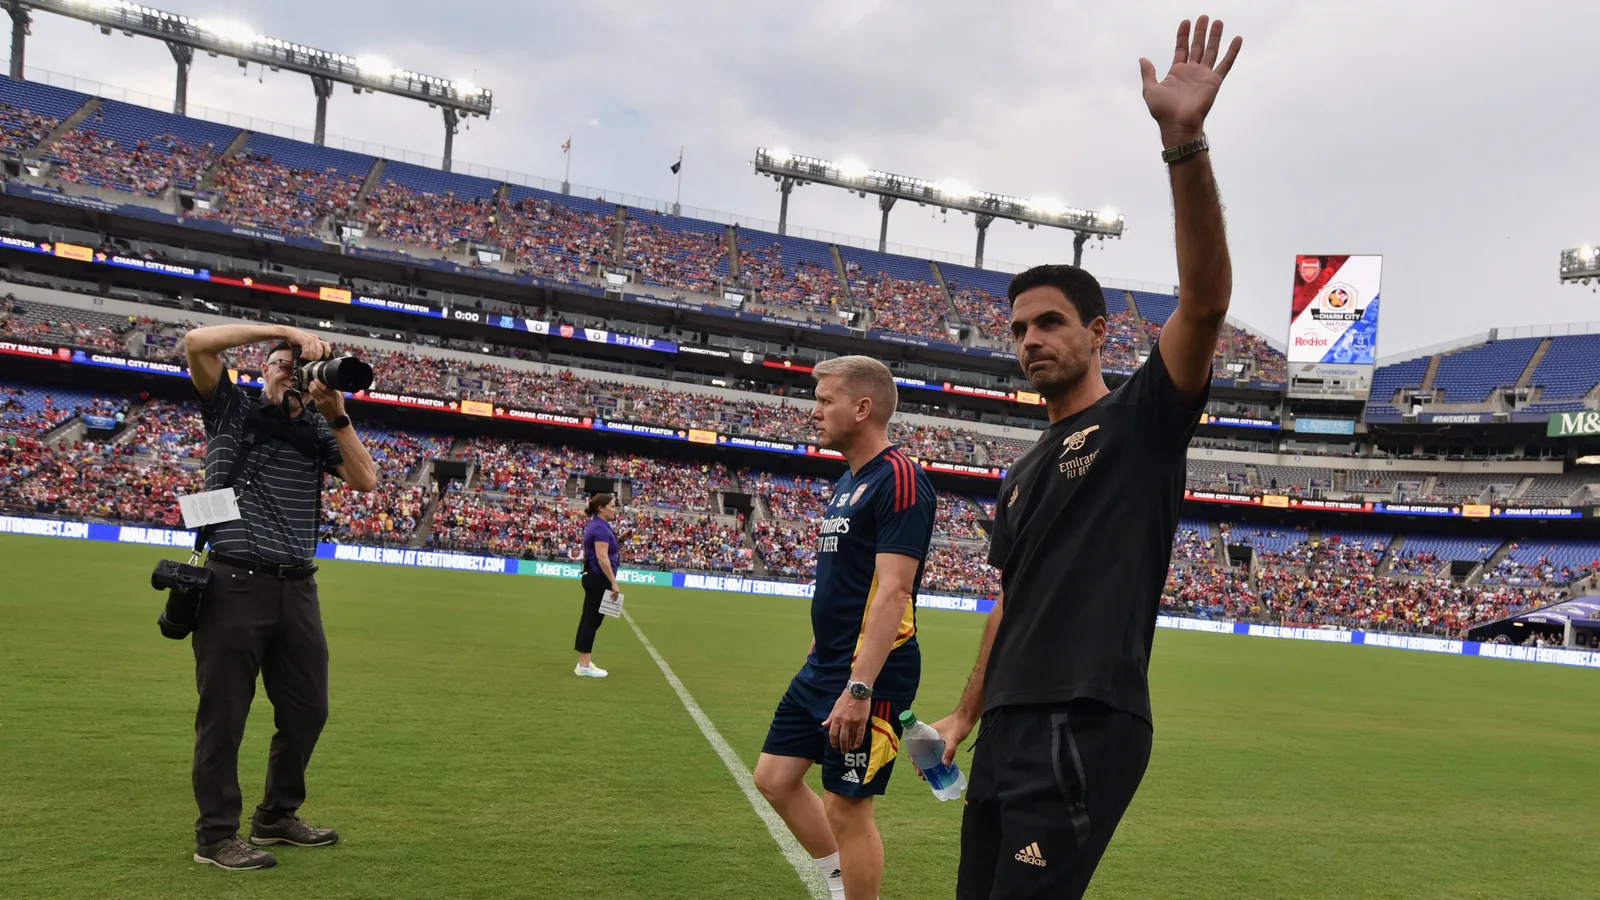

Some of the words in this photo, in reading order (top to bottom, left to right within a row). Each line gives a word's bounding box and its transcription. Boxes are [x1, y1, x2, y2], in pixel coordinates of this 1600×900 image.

[232, 227, 255, 237] ARTHUR
[263, 232, 286, 242] MODELL
[2, 236, 35, 248] MATCH
[112, 256, 144, 267] CHARM
[145, 261, 165, 271] CITY
[165, 264, 195, 276] MATCH
[359, 296, 386, 307] CHARM
[387, 301, 404, 309] CITY
[404, 303, 429, 314] MATCH
[636, 296, 656, 305] MICHAEL
[454, 310, 480, 322] 0:00
[629, 336, 655, 348] HALF
[18, 345, 53, 356] MATCH
[679, 346, 730, 358] #CHARMCITYMATCH
[92, 353, 126, 366] CHARM
[127, 358, 149, 369] CITY
[149, 361, 181, 373] MATCH
[1316, 368, 1358, 376] Constellation
[953, 385, 974, 393] CHARM
[369, 391, 399, 402] CHARM
[399, 395, 417, 404] CITY
[417, 397, 445, 408] MATCH
[509, 409, 536, 419] CHARM
[537, 413, 553, 421] CITY
[553, 416, 579, 424] MATCH
[1219, 416, 1239, 424] CHARM
[1432, 414, 1481, 423] #RAVENSFLOCK
[607, 421, 633, 431] CHARM
[633, 425, 650, 433] CITY
[649, 427, 674, 436] MATCH
[731, 437, 756, 447] CHARM
[771, 442, 794, 451] MATCH
[931, 462, 954, 471] CHARM
[954, 464, 968, 472] CITY
[968, 466, 989, 474] MATCH
[1067, 469, 1076, 479] FLY
[1193, 491, 1215, 499] CHARM
[1302, 499, 1325, 507] CHARM
[1386, 504, 1410, 512] CHARM
[1505, 508, 1531, 516] CHARM
[1532, 508, 1548, 516] CITY
[1547, 508, 1572, 516] MATCH
[820, 514, 850, 534] mirates
[119, 526, 172, 546] AVAILABLE
[171, 530, 196, 547] NOW
[335, 544, 382, 563] AVAILABLE
[382, 548, 401, 565] NOW
[404, 550, 417, 566] AT
[417, 552, 505, 573] EVERTONDIRECT.COM
[535, 562, 563, 576] M&T
[616, 570, 632, 581] &T
[632, 571, 656, 583] Bank
[684, 574, 724, 590] AVAILABLE
[724, 577, 742, 592] NOW
[742, 579, 753, 592] AT
[753, 580, 815, 598] EVERTONDIRECT.C
[1248, 625, 1280, 638] AVAILABLE
[1280, 627, 1295, 639] NOW
[1295, 628, 1303, 639] AT
[1364, 632, 1389, 646] AVAILABLE
[1479, 643, 1512, 659] AVAILABLE
[1512, 645, 1527, 661] NOW
[1526, 647, 1536, 661] AT
[844, 752, 867, 768] SR
[842, 775, 860, 784] adidas
[1014, 853, 1047, 867] adidas
